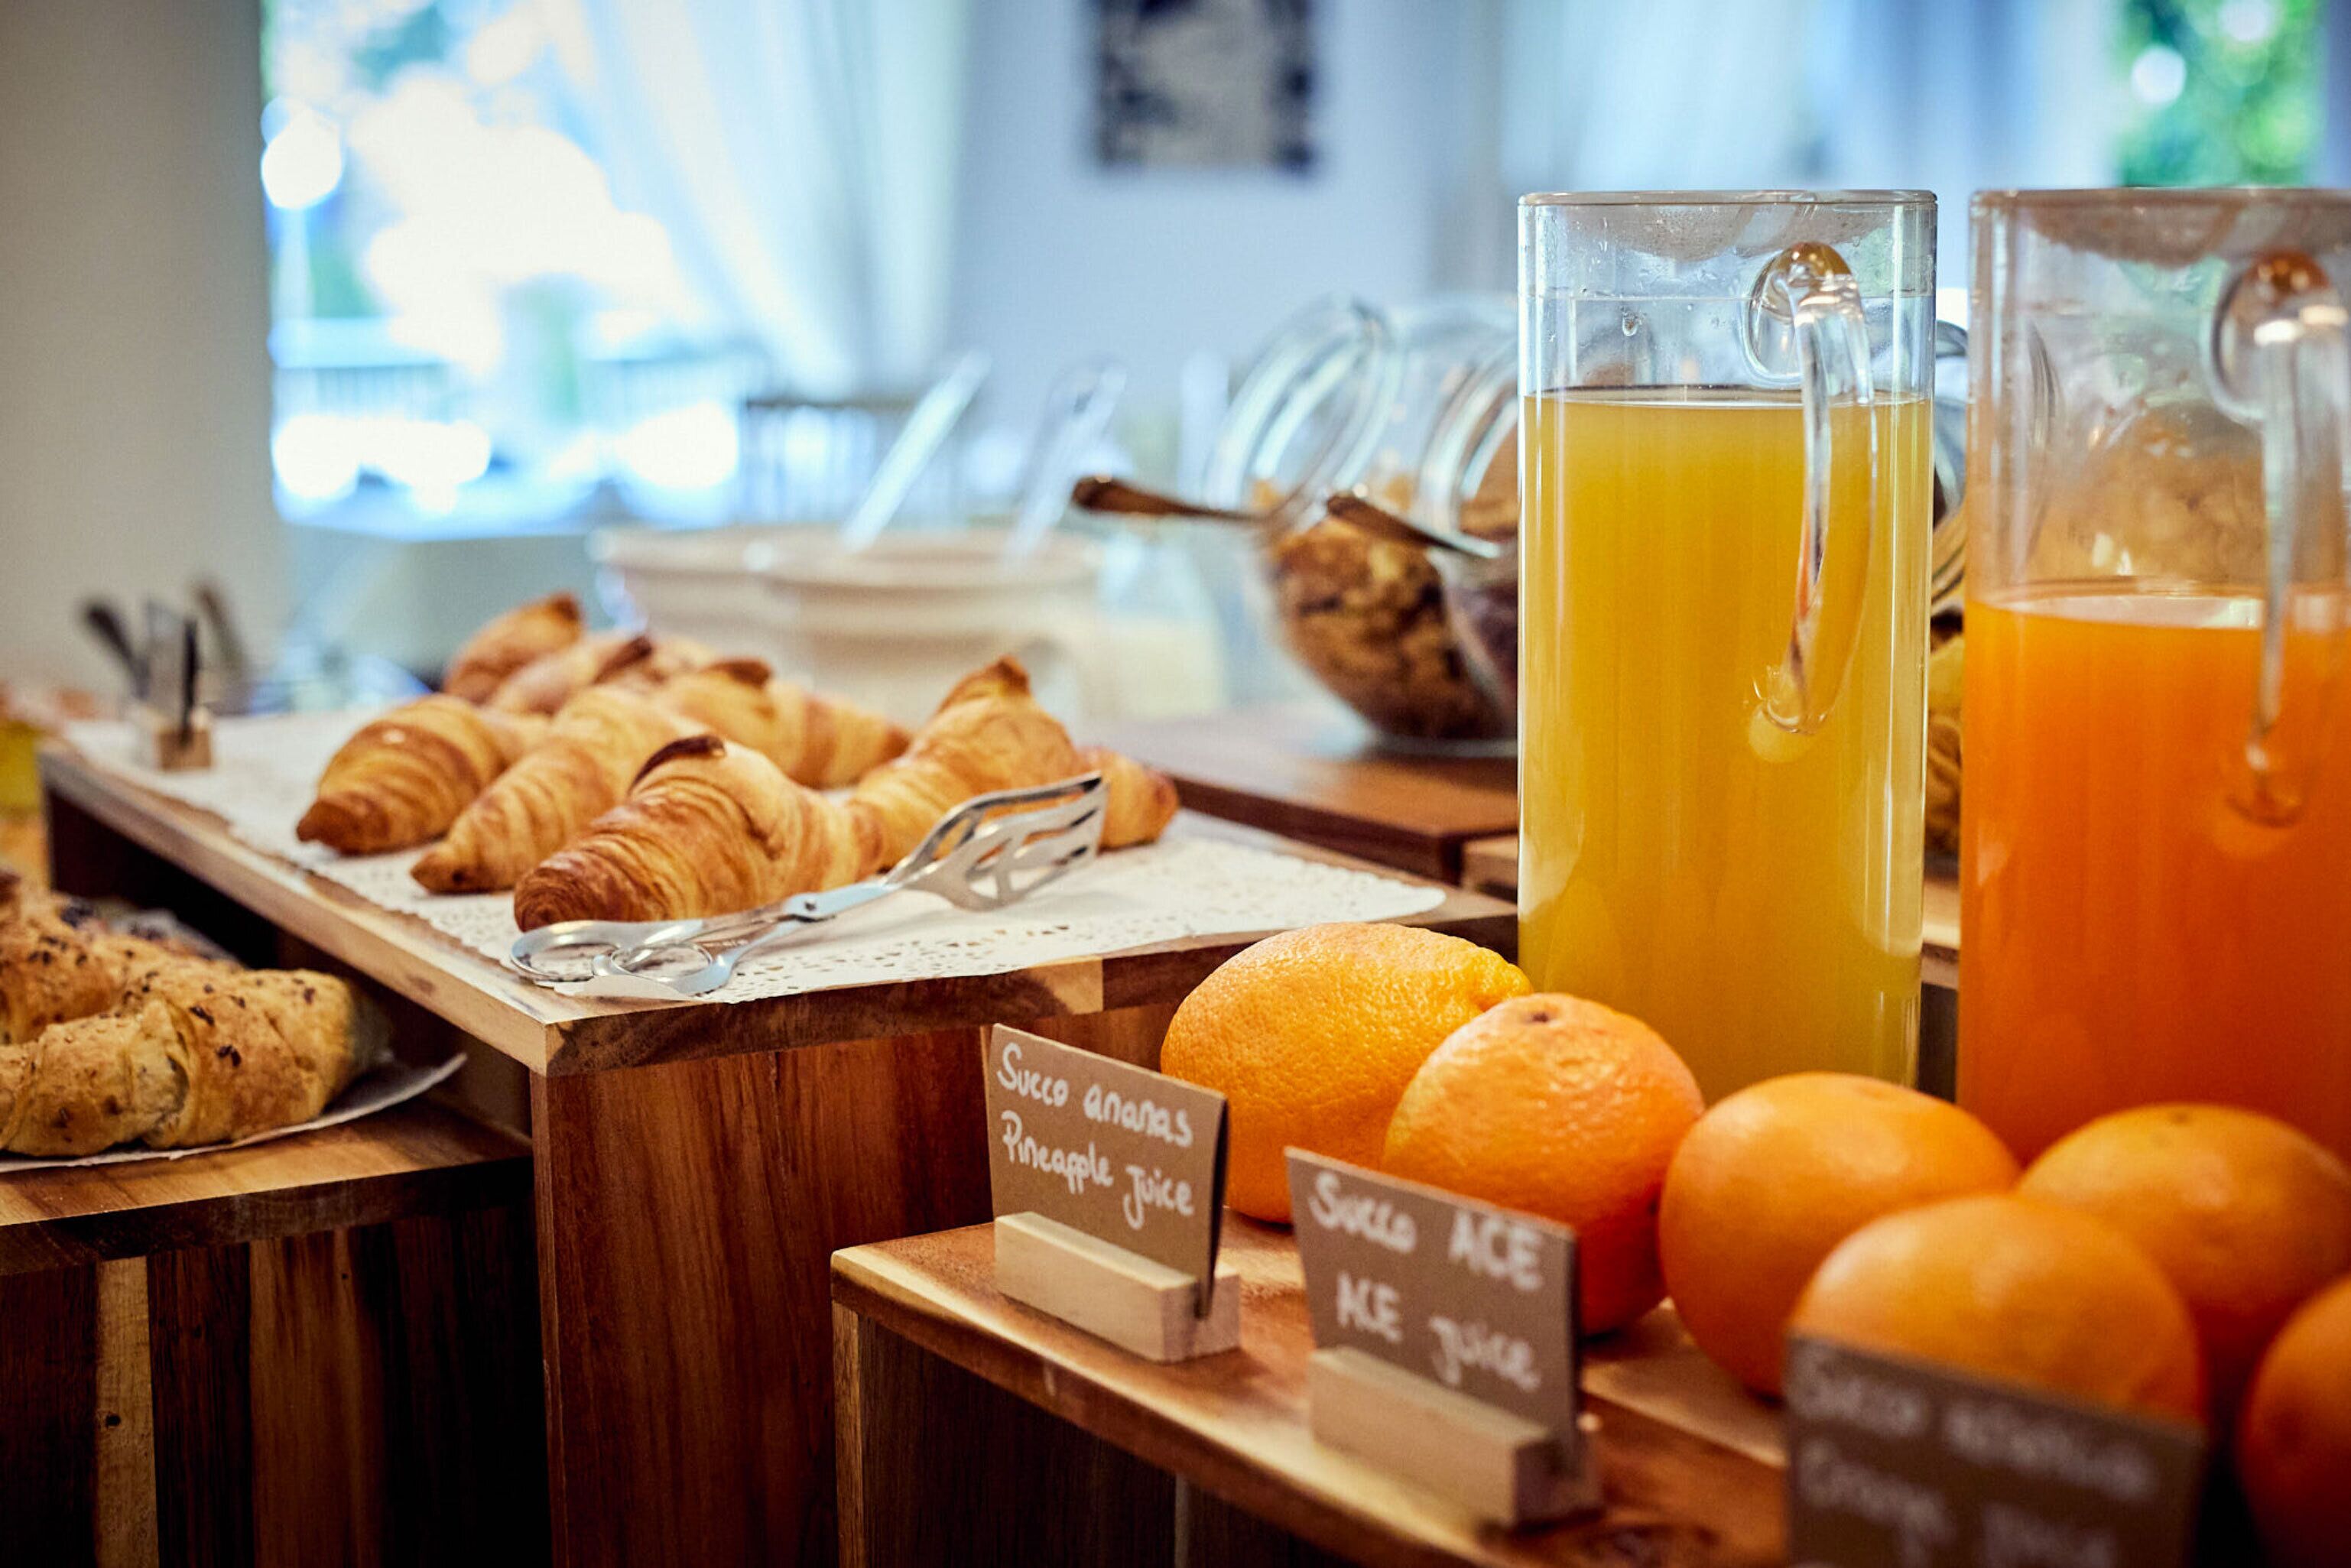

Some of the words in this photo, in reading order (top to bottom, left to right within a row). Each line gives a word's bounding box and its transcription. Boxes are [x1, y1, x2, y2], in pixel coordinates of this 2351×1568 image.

[996, 1042, 1068, 1107] Succo
[1001, 1110, 1114, 1194] Pineapple
[1307, 1170, 1417, 1254] Succo
[1450, 1208, 1543, 1292] ACE
[1335, 1270, 1402, 1343] ACE
